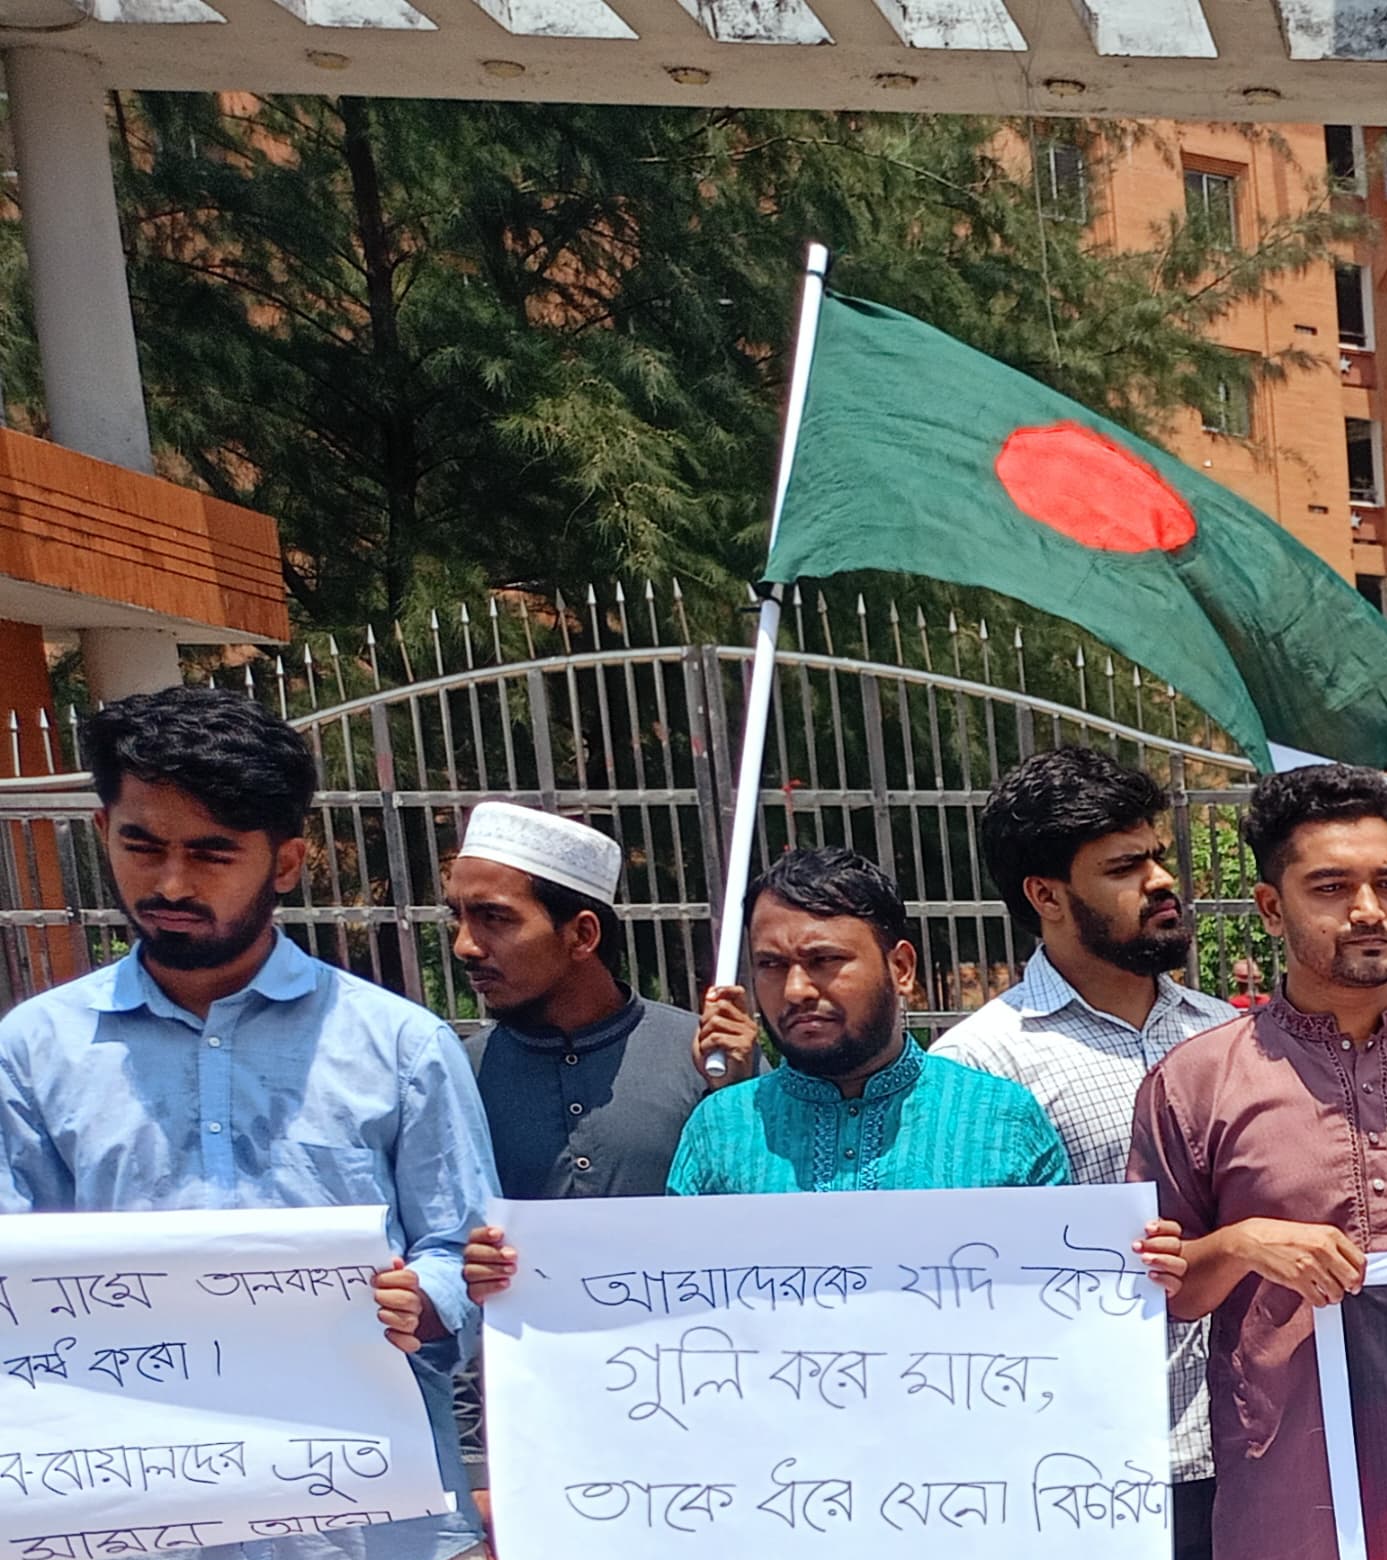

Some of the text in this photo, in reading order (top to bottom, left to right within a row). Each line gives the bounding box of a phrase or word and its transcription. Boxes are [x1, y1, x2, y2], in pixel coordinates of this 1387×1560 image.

[32, 1272, 168, 1319] নামে
[582, 1224, 1147, 1320] আমাদেরকে যদি কেউ
[89, 1342, 190, 1387] করো
[606, 1326, 759, 1430] গুলি
[770, 1350, 888, 1408] করে
[272, 1439, 388, 1503] দ্রুত
[565, 1482, 736, 1532] তাকে
[757, 1458, 854, 1531] ধরে
